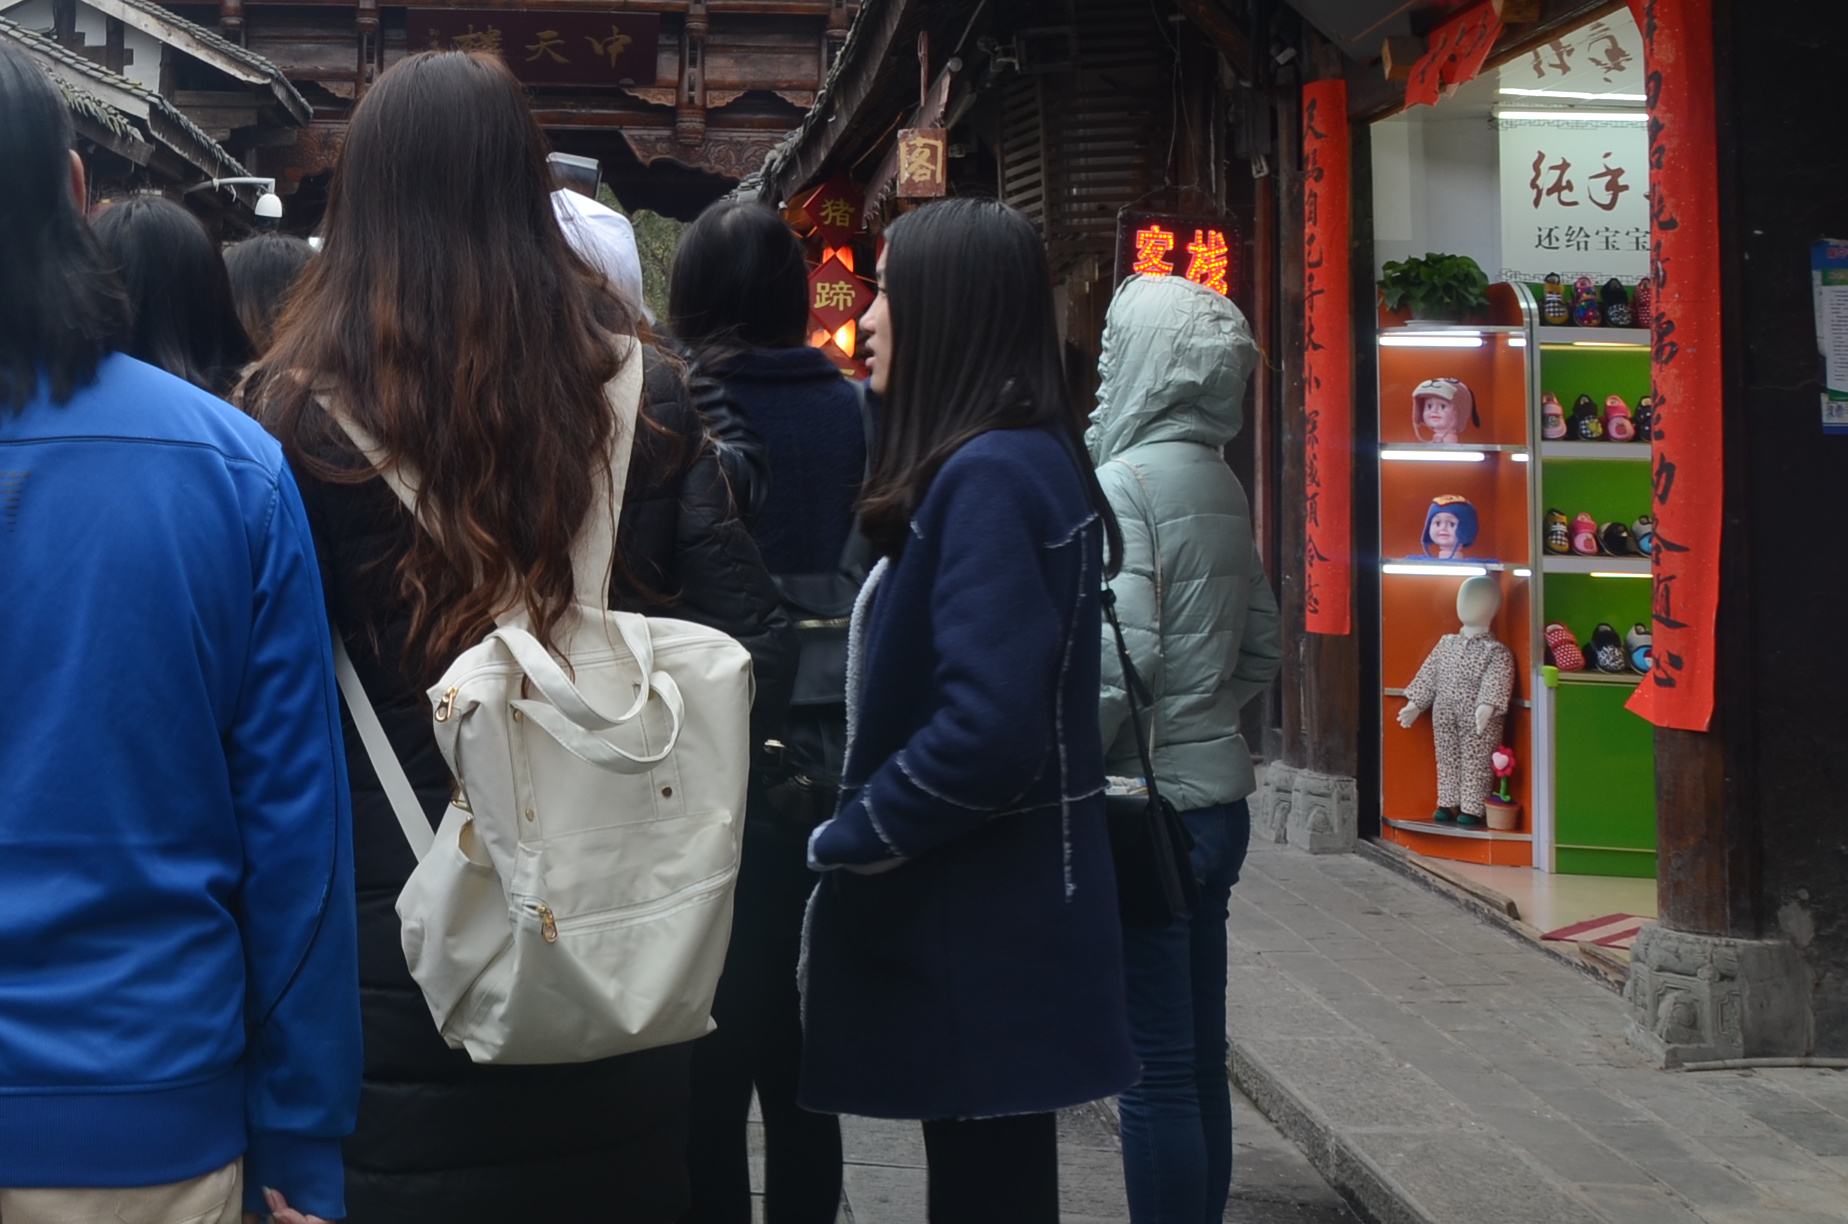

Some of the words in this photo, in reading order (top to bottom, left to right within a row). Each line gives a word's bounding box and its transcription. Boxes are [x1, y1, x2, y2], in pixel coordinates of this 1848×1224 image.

[899, 136, 944, 184] 阁
[1530, 150, 1650, 211] 纯手
[1133, 224, 1228, 295] 客栈
